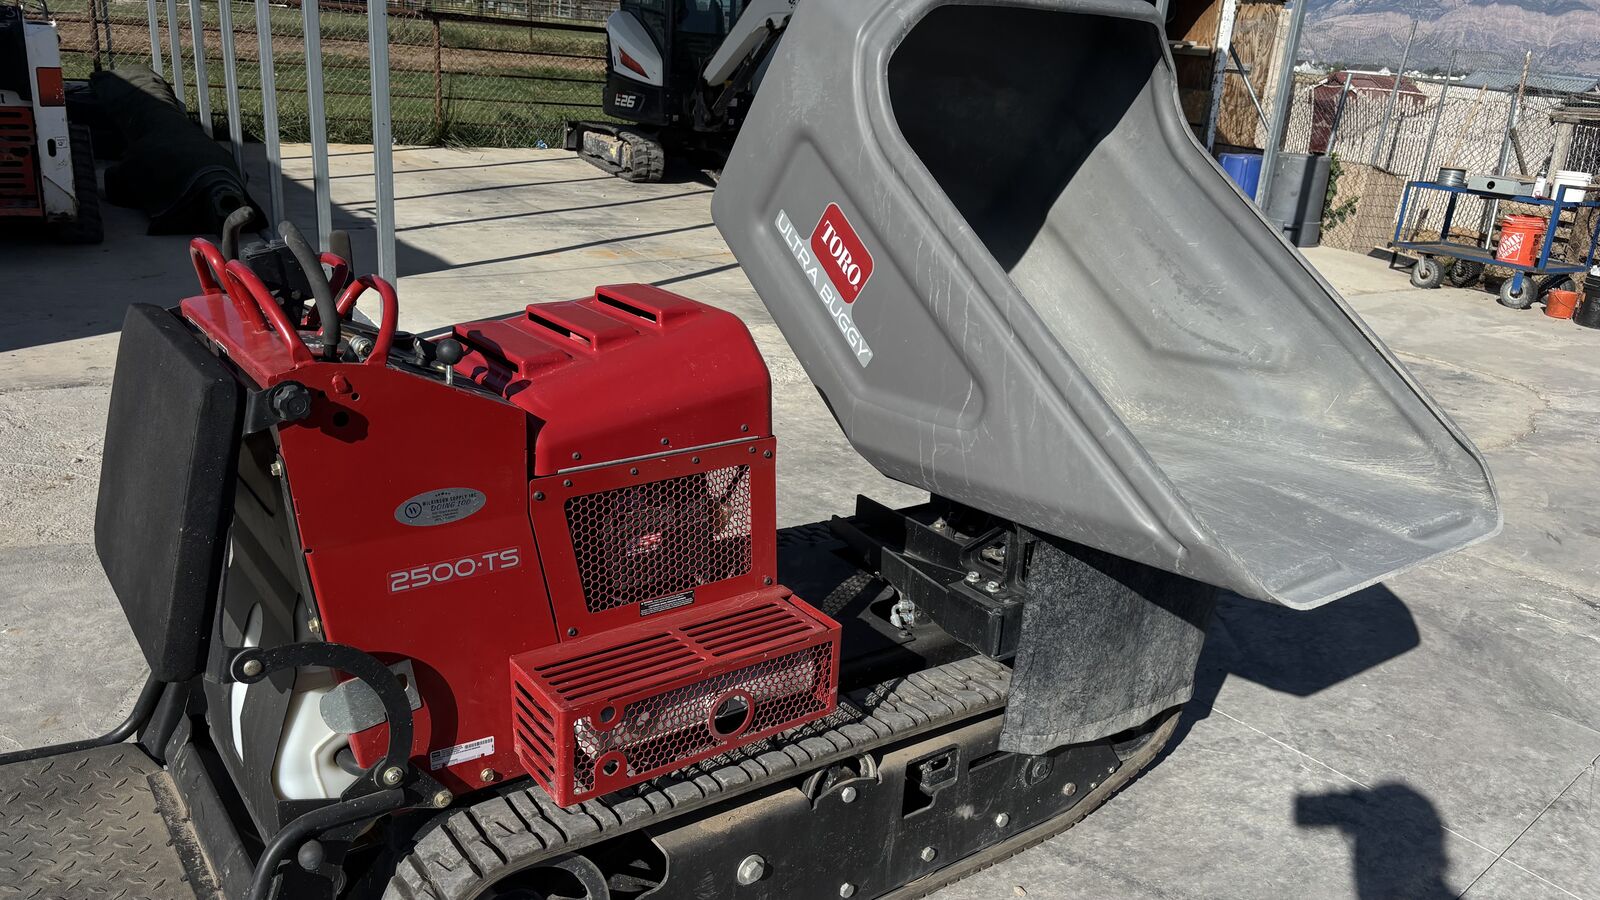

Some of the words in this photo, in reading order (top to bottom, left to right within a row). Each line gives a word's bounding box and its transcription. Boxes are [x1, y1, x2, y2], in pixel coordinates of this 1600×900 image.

[615, 93, 636, 108] E26
[777, 213, 819, 286] ULTRA
[819, 283, 870, 356] BUGGY
[820, 220, 862, 286] TORO
